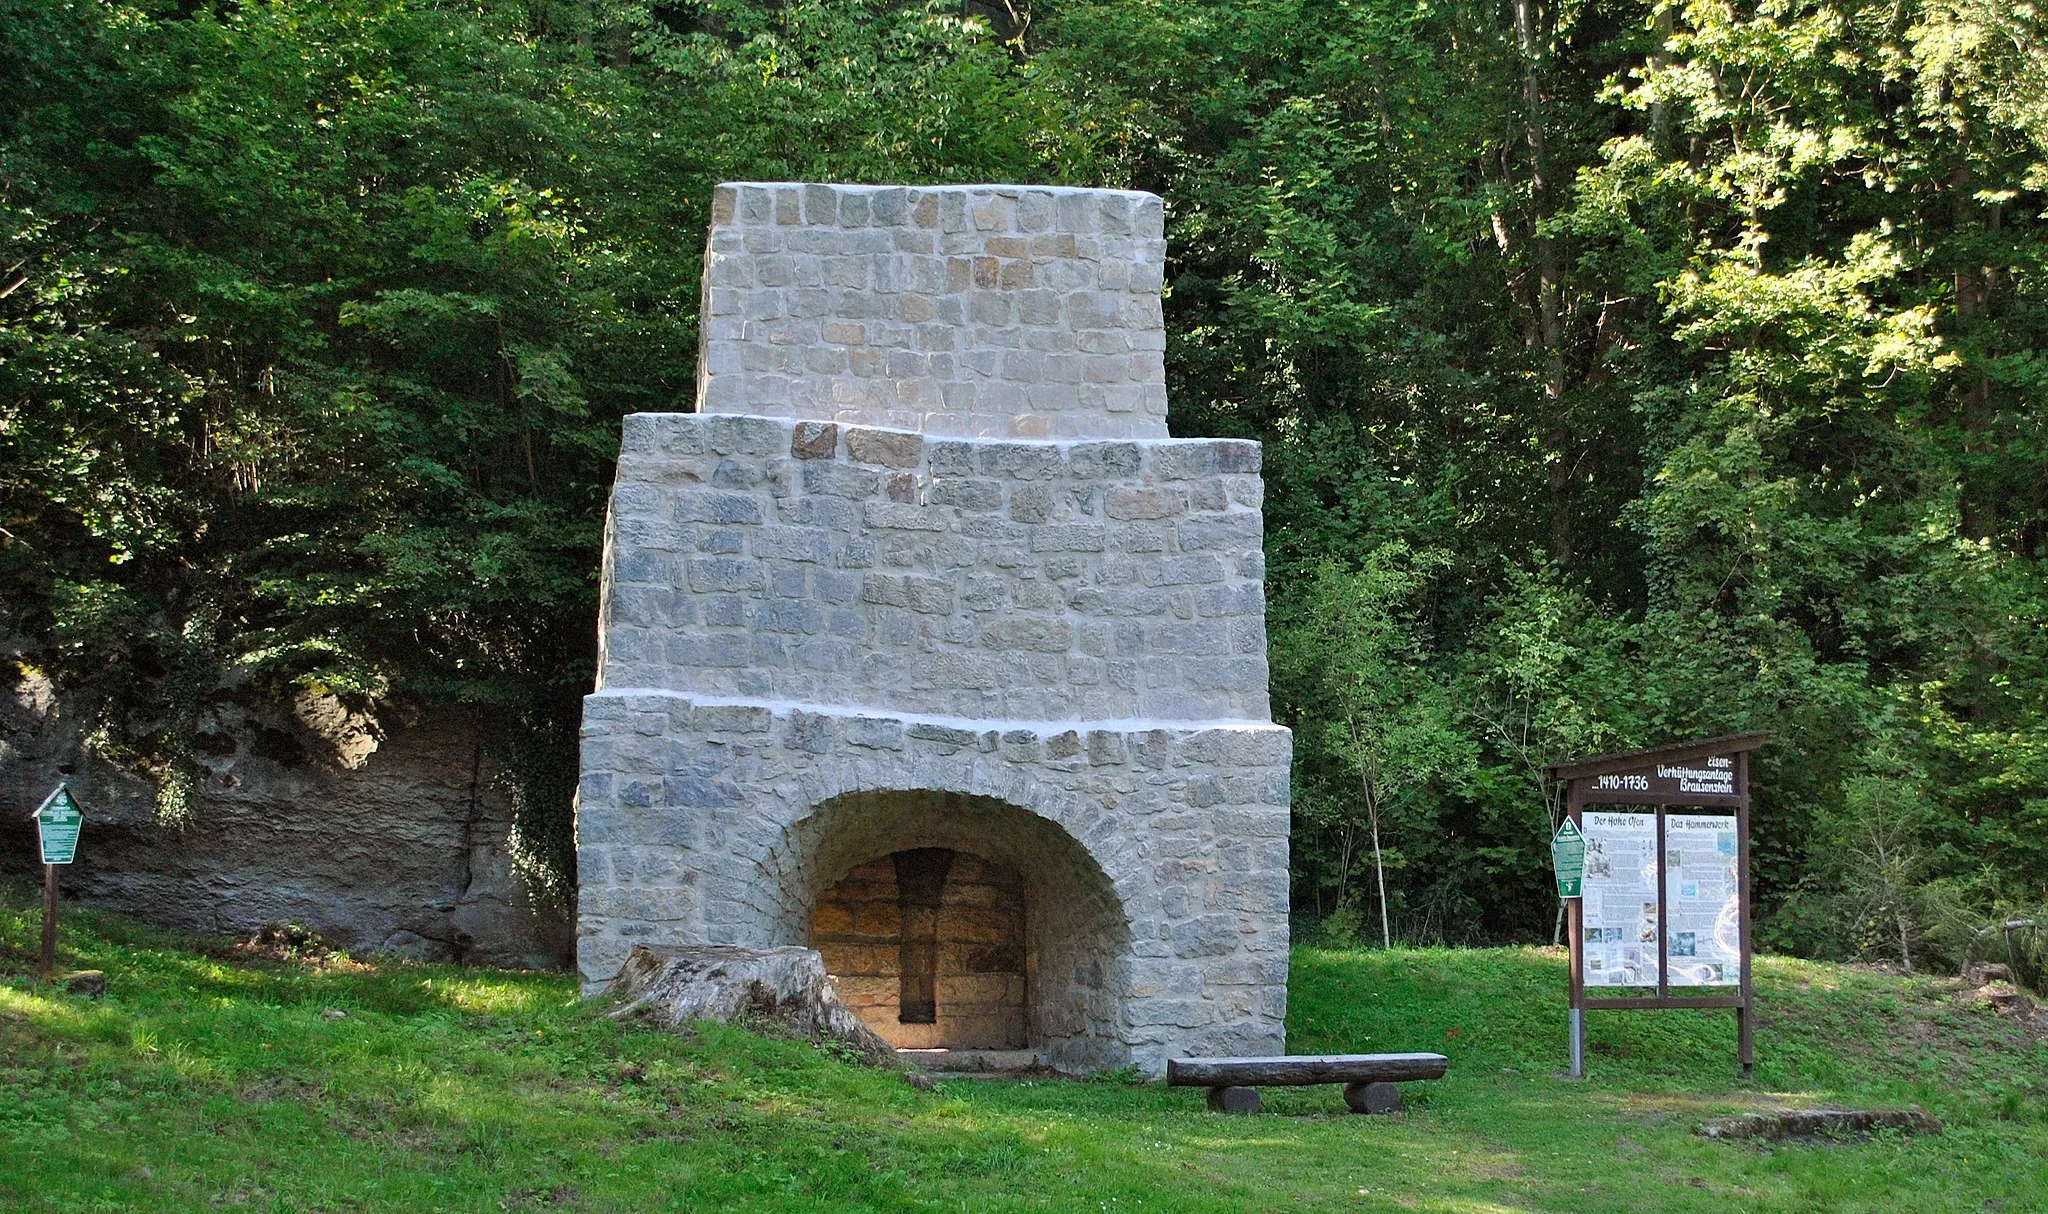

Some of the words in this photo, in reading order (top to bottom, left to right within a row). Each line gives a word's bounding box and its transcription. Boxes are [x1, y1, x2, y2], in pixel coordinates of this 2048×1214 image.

[1707, 755, 1733, 768] Eisen-
[1656, 763, 1733, 783] Verhüttungsanlage
[1679, 778, 1733, 793] Brausenstein
[1594, 815, 1606, 826] Der
[1608, 816, 1626, 828] Hohe
[1628, 815, 1644, 828] Ofen
[1671, 818, 1683, 829] Das
[1685, 819, 1729, 830] Hammerwerk
